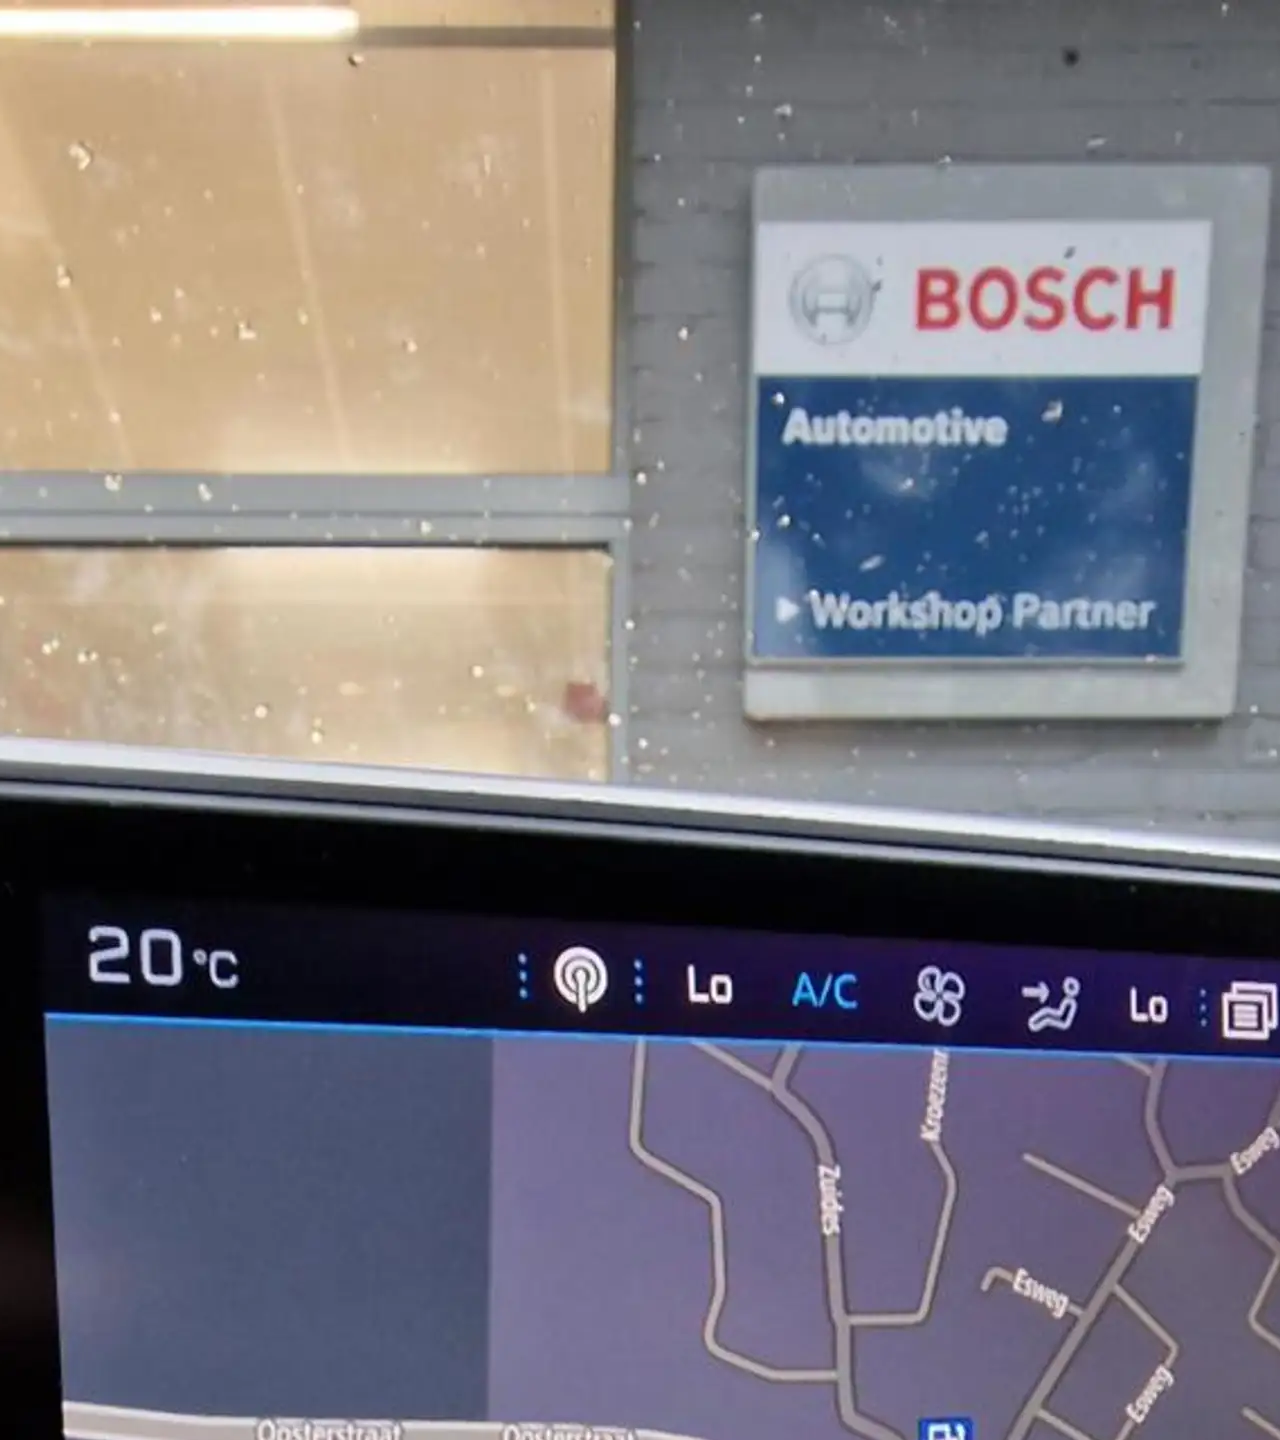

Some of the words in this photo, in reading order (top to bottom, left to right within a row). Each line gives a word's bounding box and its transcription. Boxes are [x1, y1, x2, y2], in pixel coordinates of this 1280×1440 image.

[915, 266, 1176, 331] BOSCH
[782, 407, 1008, 446] Automotive
[810, 590, 1002, 635] Workshop
[1013, 591, 1157, 629] Partner
[686, 964, 733, 1004] Lo
[792, 970, 859, 1009] A/C
[1129, 985, 1168, 1023] Lo
[1012, 1267, 1069, 1318] Esweg
